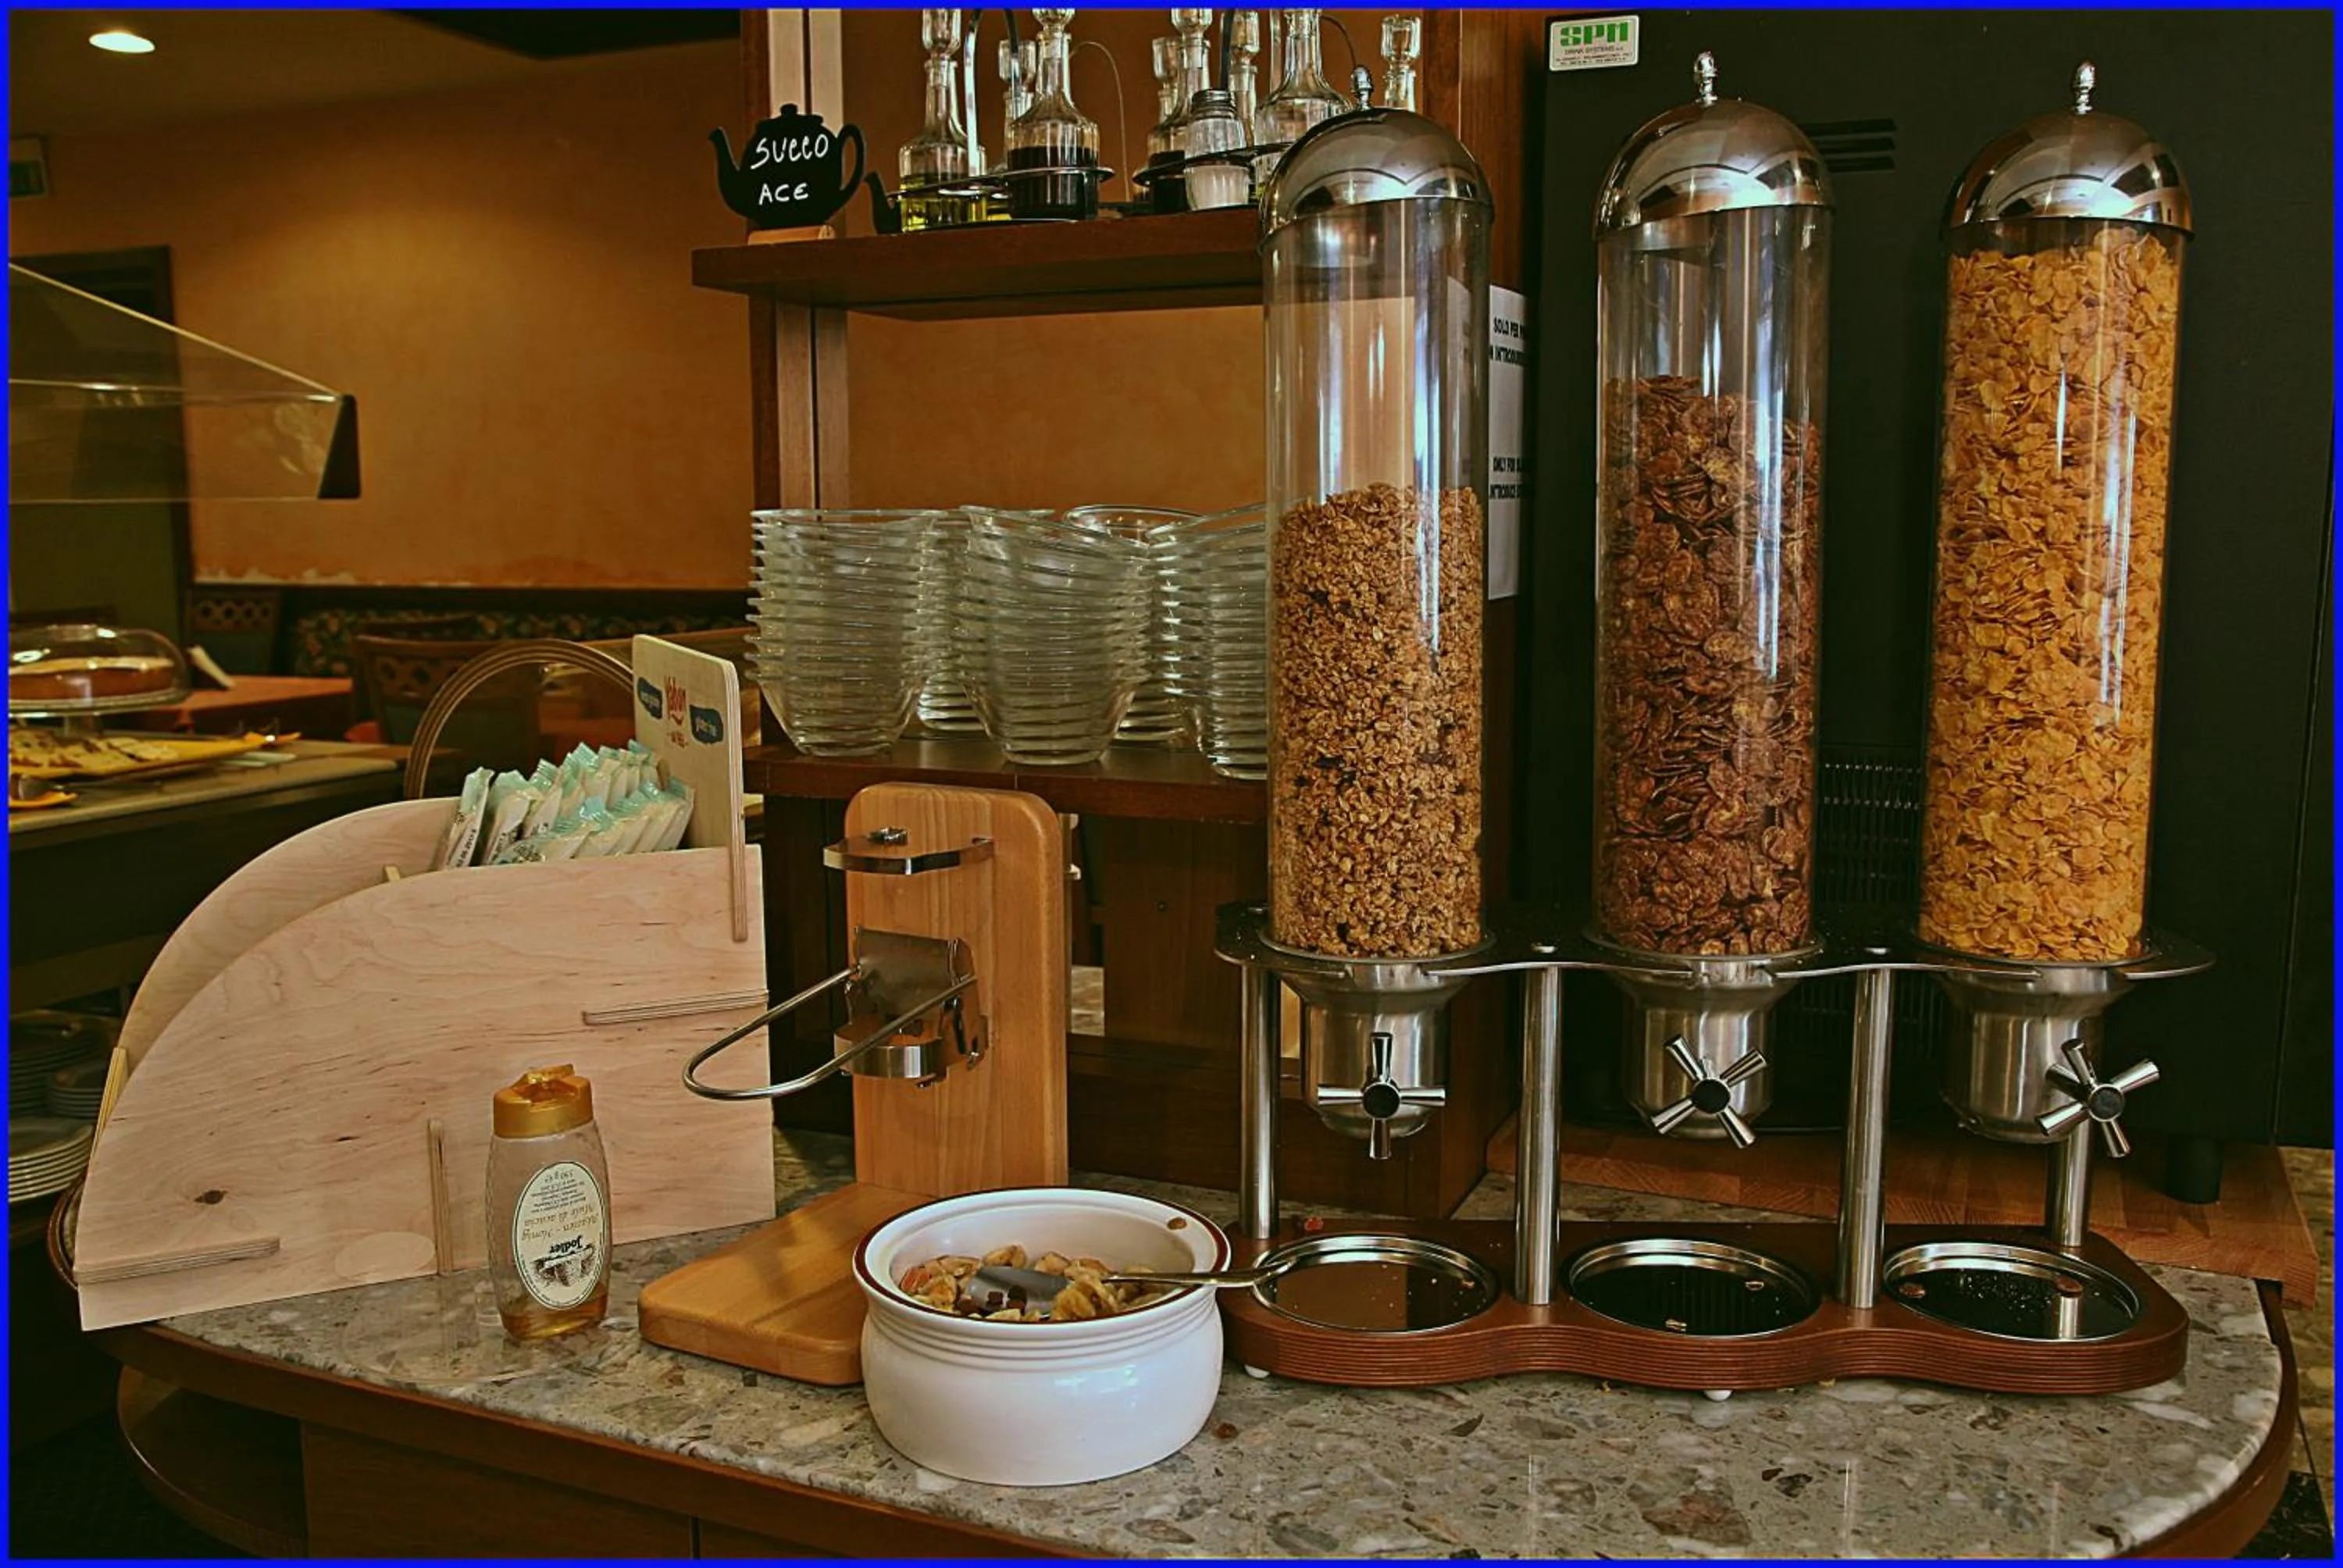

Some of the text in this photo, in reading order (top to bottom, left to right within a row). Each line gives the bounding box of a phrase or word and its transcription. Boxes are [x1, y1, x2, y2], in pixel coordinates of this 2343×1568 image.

[758, 183, 809, 205] ACE
[1493, 316, 1509, 335] SOLO
[1510, 321, 1520, 337] PER
